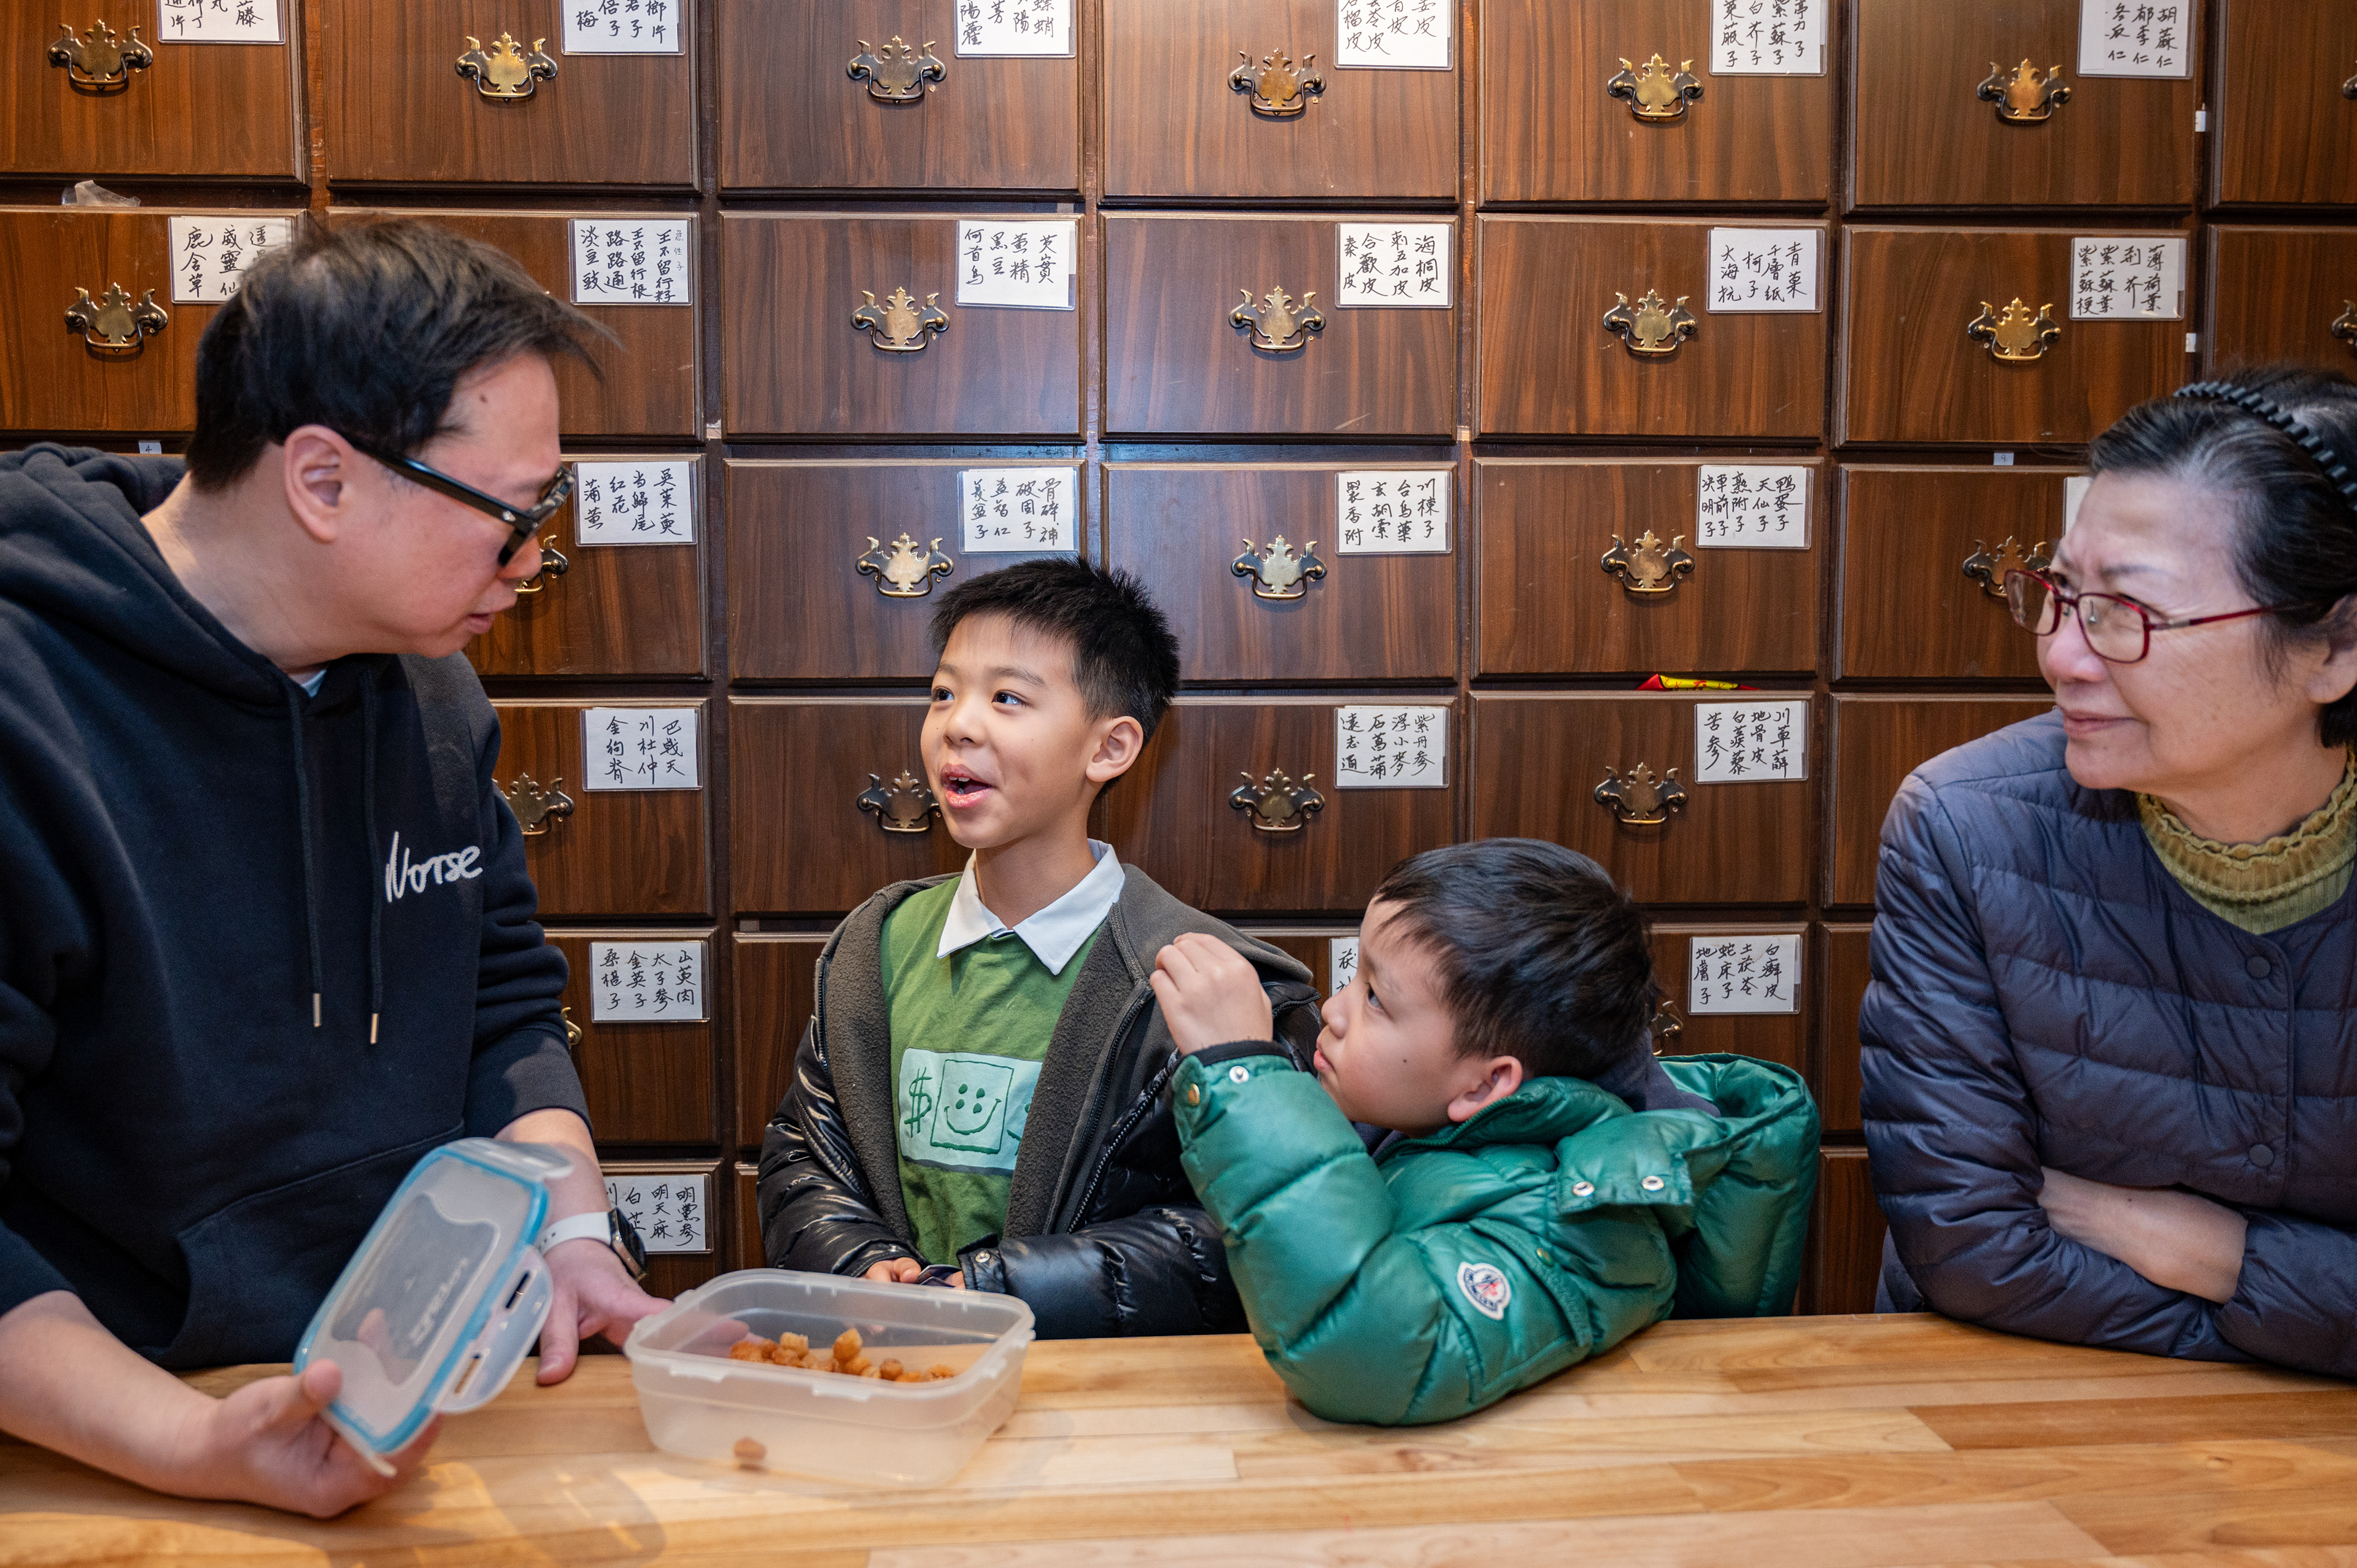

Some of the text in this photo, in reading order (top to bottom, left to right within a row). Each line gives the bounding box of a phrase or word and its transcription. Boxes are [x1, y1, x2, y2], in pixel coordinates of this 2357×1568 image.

[604, 230, 630, 290] 路路通
[630, 228, 653, 299] 王不留行根
[990, 232, 1007, 275] 黑豆
[1389, 231, 1413, 298] 刺五加皮
[1415, 235, 1440, 293] 海桐皮
[1752, 477, 1776, 532] 天仙子
